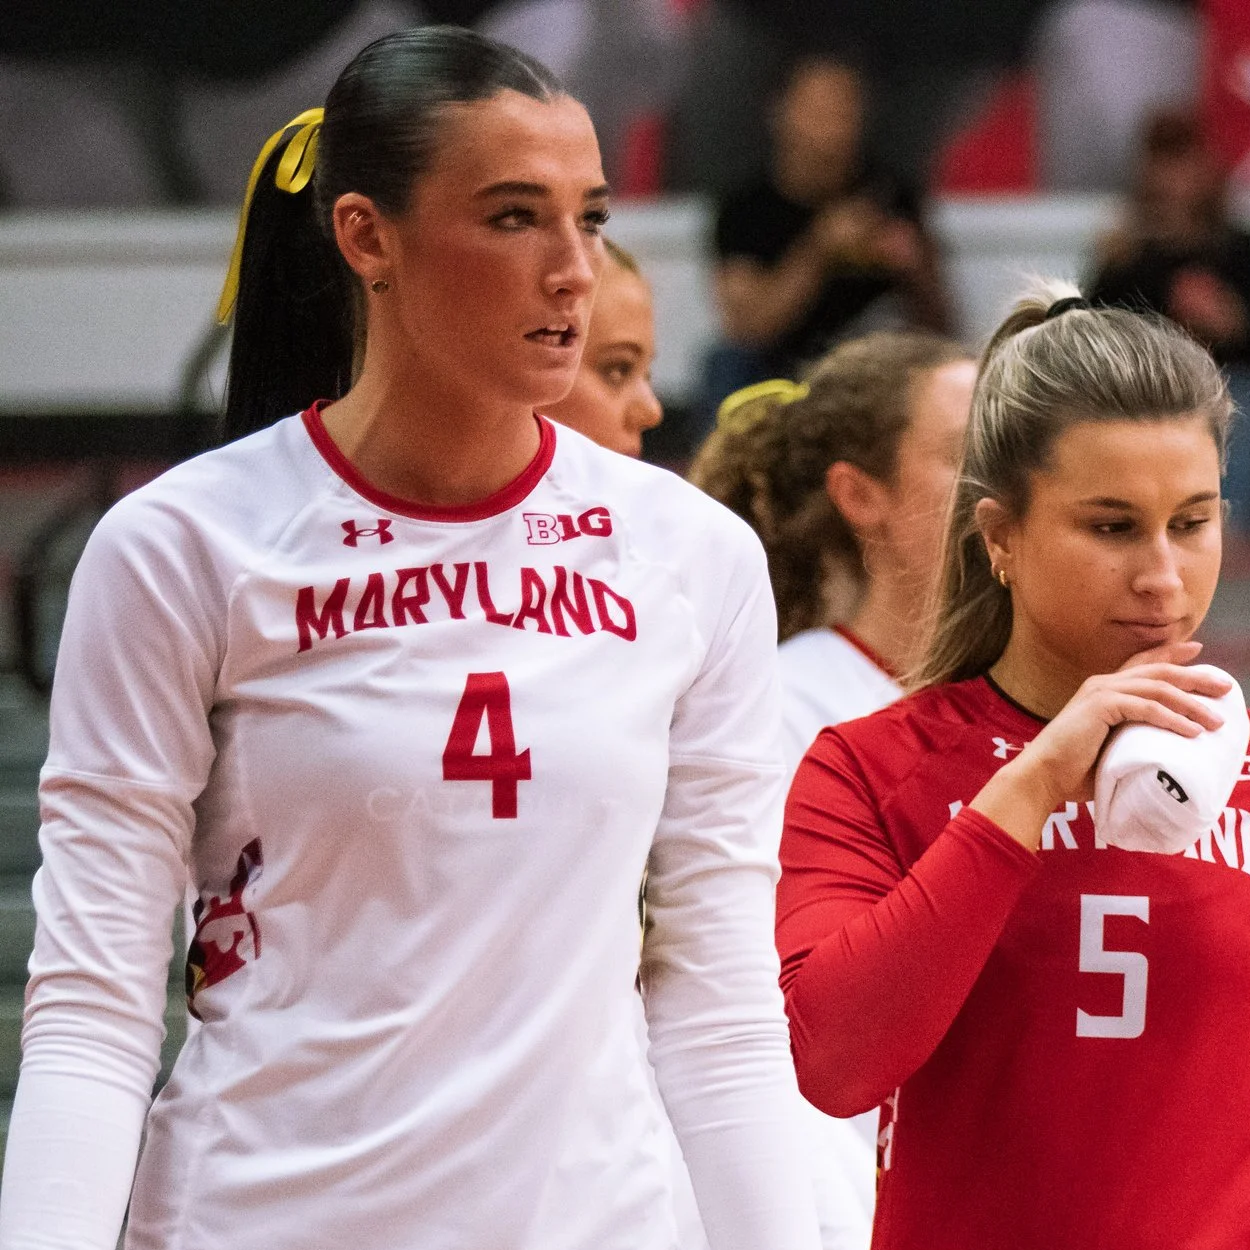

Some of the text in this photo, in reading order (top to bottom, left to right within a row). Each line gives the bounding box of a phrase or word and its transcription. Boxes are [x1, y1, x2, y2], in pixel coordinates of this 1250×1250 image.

[295, 561, 637, 653] MARYLAND
[442, 671, 532, 819] 4
[1076, 894, 1150, 1039] 5
